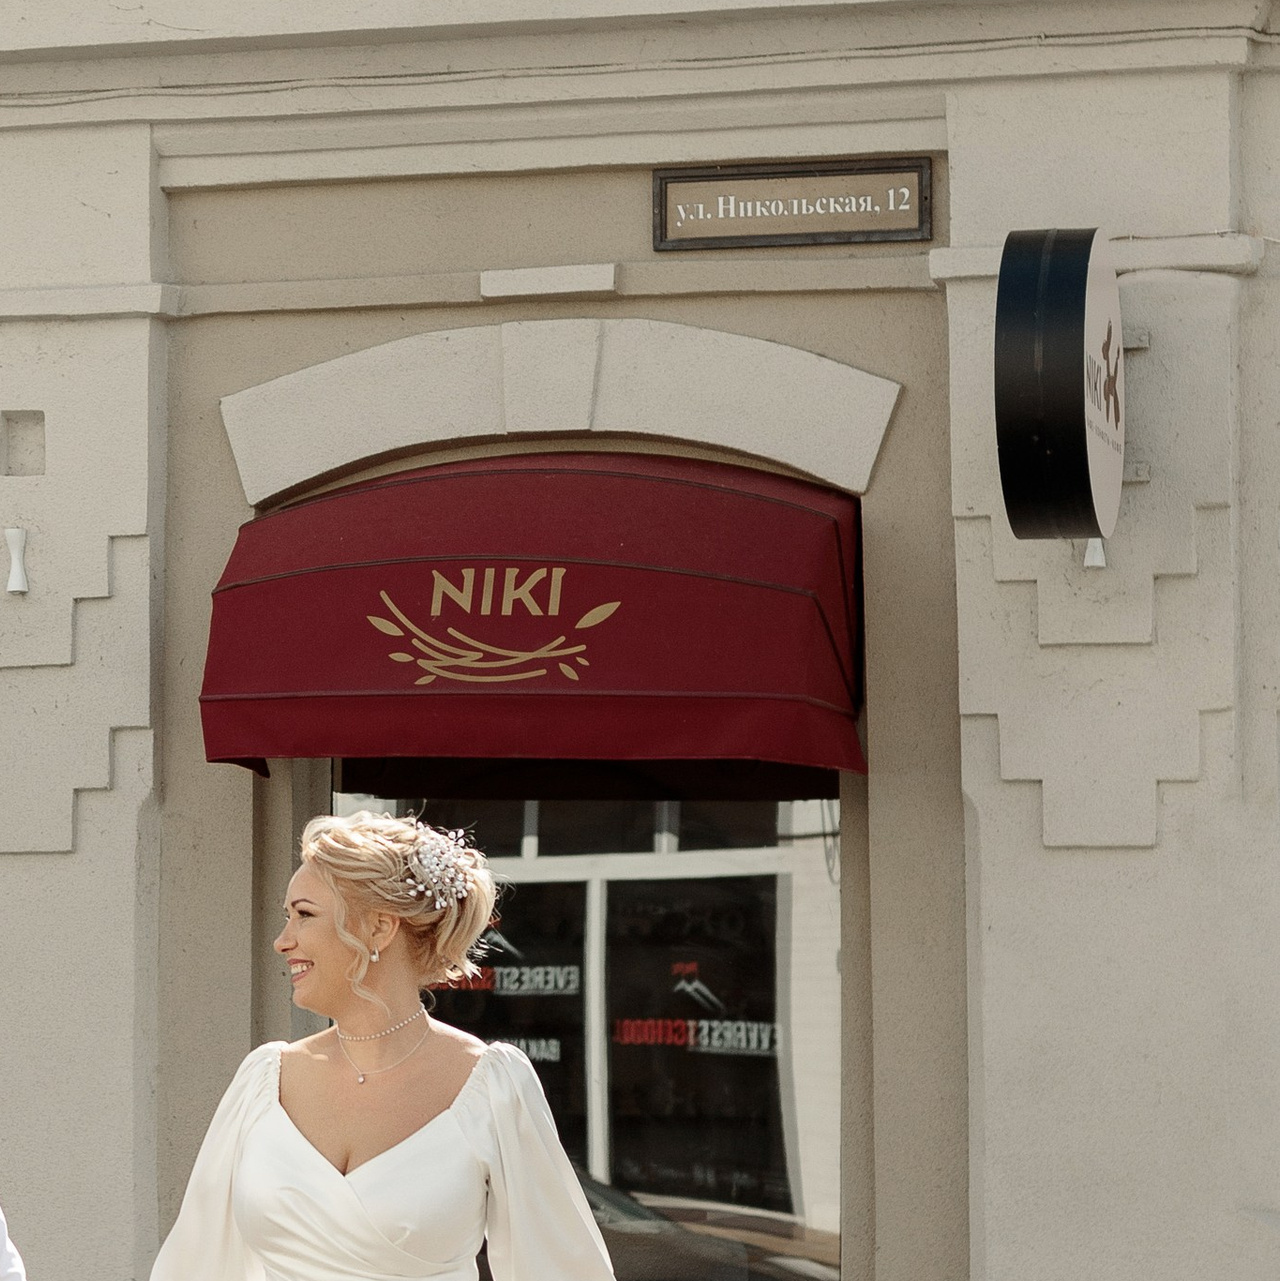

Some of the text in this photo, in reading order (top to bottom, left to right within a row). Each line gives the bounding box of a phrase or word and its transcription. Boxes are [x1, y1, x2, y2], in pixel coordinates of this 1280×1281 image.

[676, 186, 911, 227] ул. Никольская, 12
[430, 567, 567, 617] NIKI
